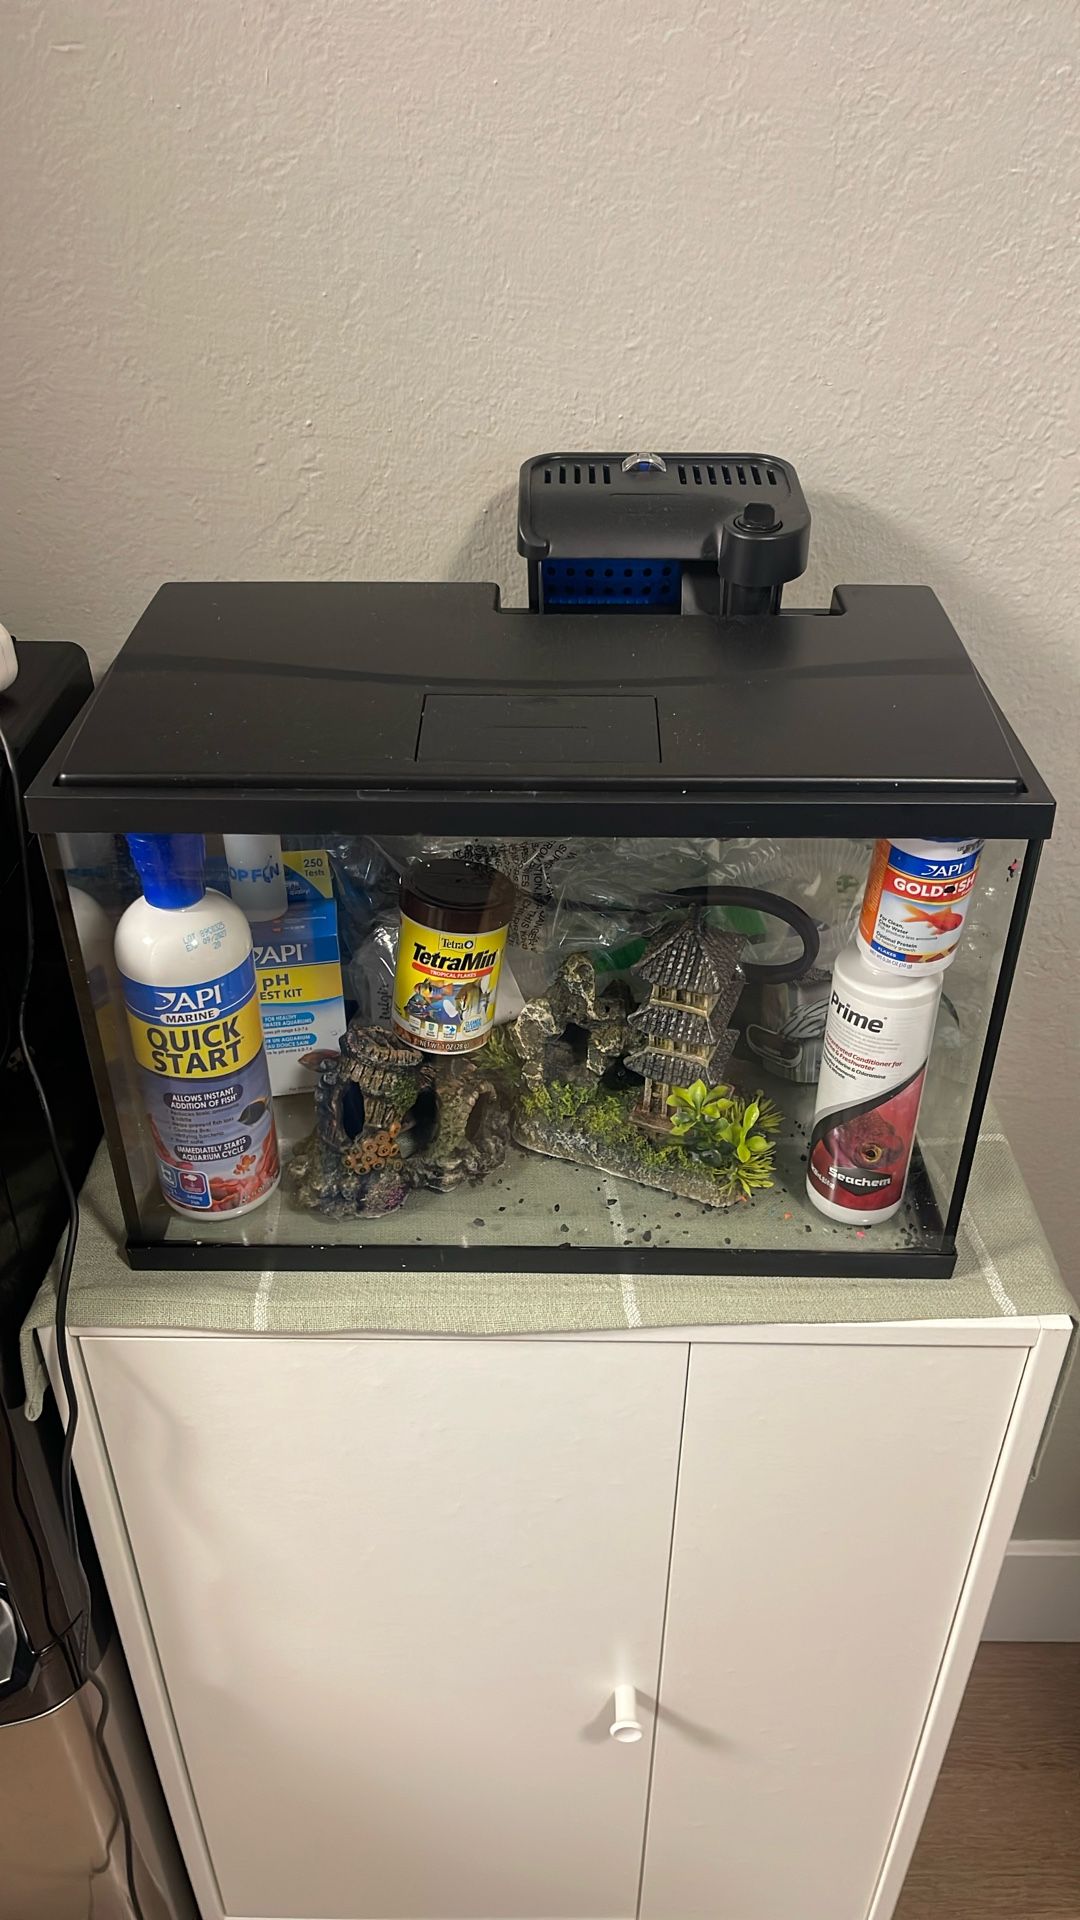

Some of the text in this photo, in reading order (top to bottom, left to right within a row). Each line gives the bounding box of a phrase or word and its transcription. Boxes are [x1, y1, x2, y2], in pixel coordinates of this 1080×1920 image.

[304, 859, 323, 868] 250
[933, 864, 962, 876] API
[304, 869, 325, 877] Tests
[879, 920, 908, 935] Clear Water
[183, 933, 196, 944] LOT
[441, 937, 464, 950] Tetra
[876, 931, 917, 949] Optimal Protein
[260, 944, 303, 964] API
[412, 942, 498, 971] TetraMin
[878, 947, 897, 958] FLAKES
[429, 969, 457, 978] TROPICAL
[263, 974, 289, 991] pH
[172, 984, 223, 1012] API
[260, 988, 303, 1000] EST KIT
[166, 1009, 215, 1023] MARINE
[830, 989, 883, 1033] Prime
[283, 1018, 312, 1027] AQUARIUMS
[147, 1015, 241, 1053] QUICK
[281, 1034, 310, 1042] AQUARIUM
[151, 1039, 242, 1074] START
[839, 1052, 875, 1071] Freshwater
[852, 1054, 891, 1067] Conditioner
[172, 1086, 235, 1103] ALLOWS INSTANT
[170, 1100, 207, 1110] ADDITION
[208, 1098, 220, 1107] OF
[177, 1137, 247, 1153] IMMEDIATELY STARTS
[182, 1146, 244, 1161] AQUARIUM CYCLE
[828, 1166, 891, 1187] Seachem
